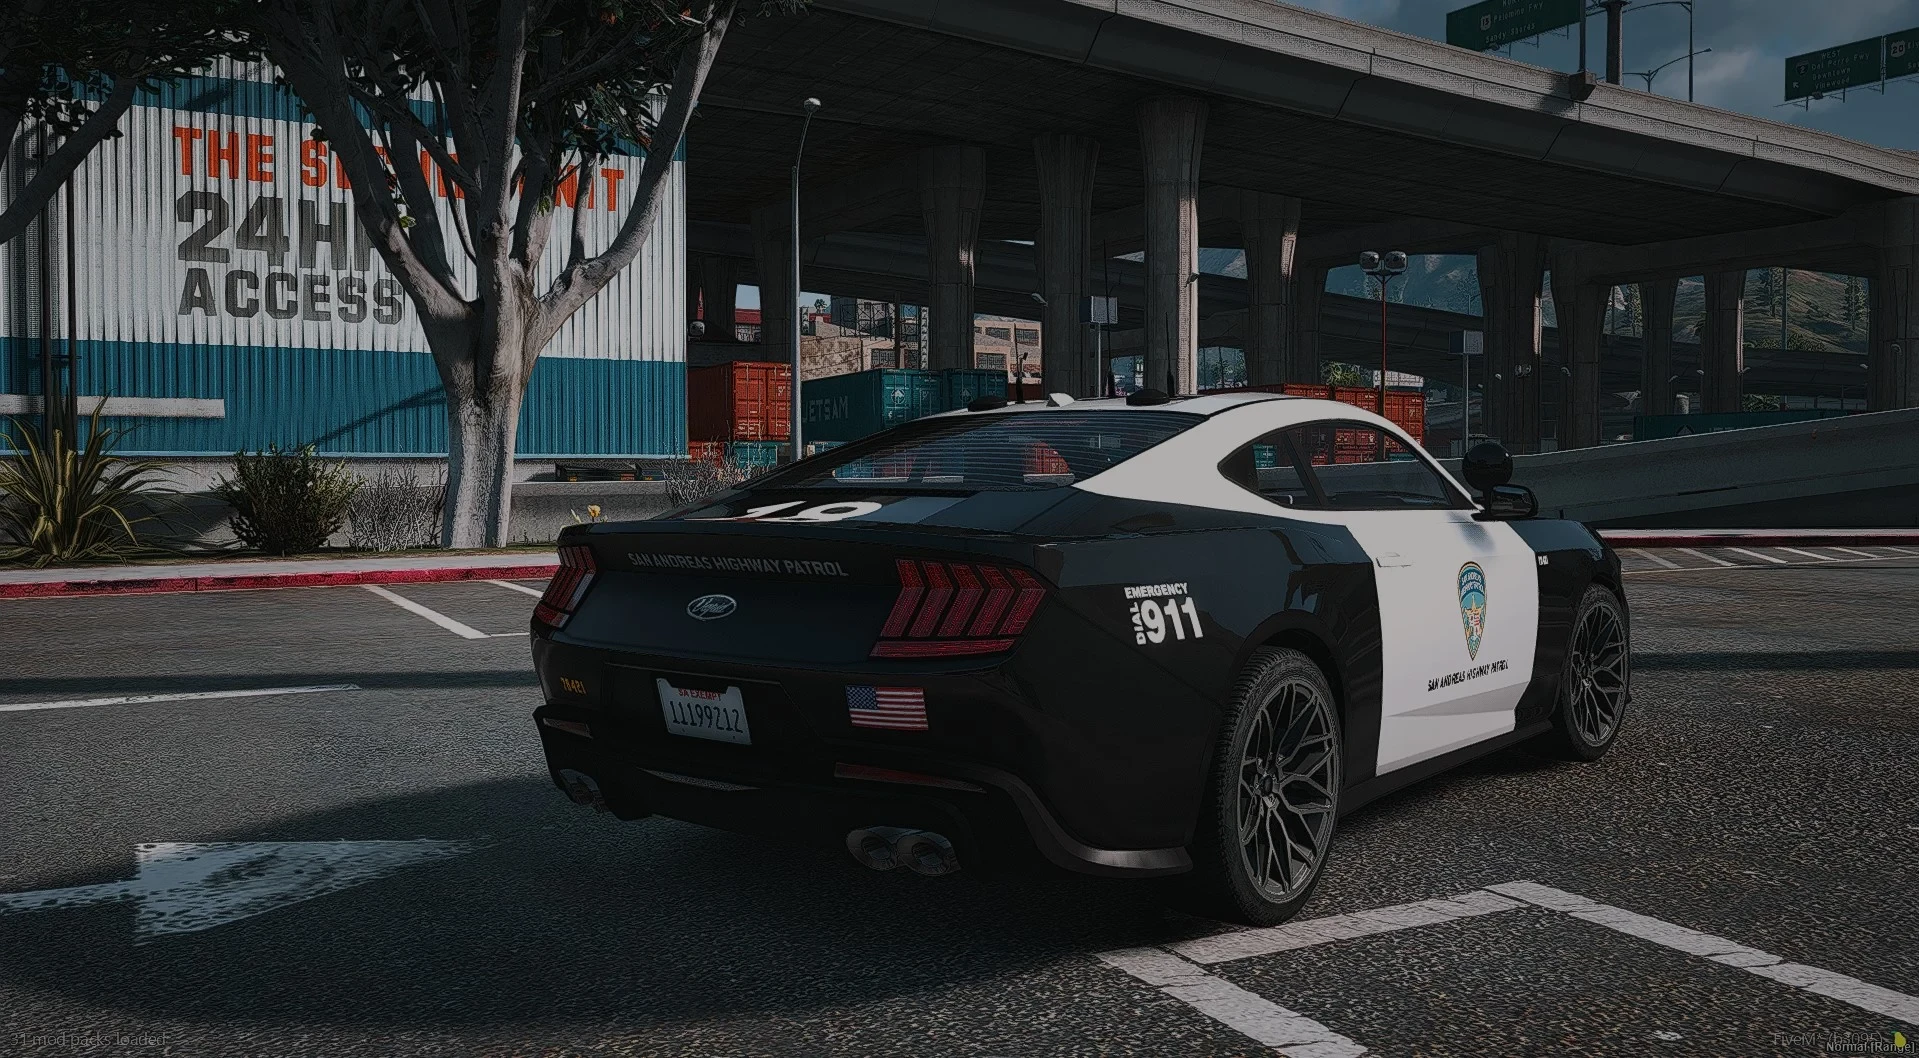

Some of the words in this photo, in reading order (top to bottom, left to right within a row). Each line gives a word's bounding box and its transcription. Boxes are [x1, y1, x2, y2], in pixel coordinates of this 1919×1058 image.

[173, 127, 273, 182] THE
[178, 267, 403, 325] ACCESS
[627, 552, 651, 567] SAN
[652, 553, 713, 570] ANDREAS
[711, 556, 780, 573] HIGHWAY
[783, 559, 849, 577] PATROL
[1124, 582, 1188, 599] EMERGENCY
[1129, 601, 1147, 646] DIAL
[1140, 596, 1204, 644] 911
[1427, 677, 1440, 692] SAN
[1440, 670, 1466, 688] ANDREAS
